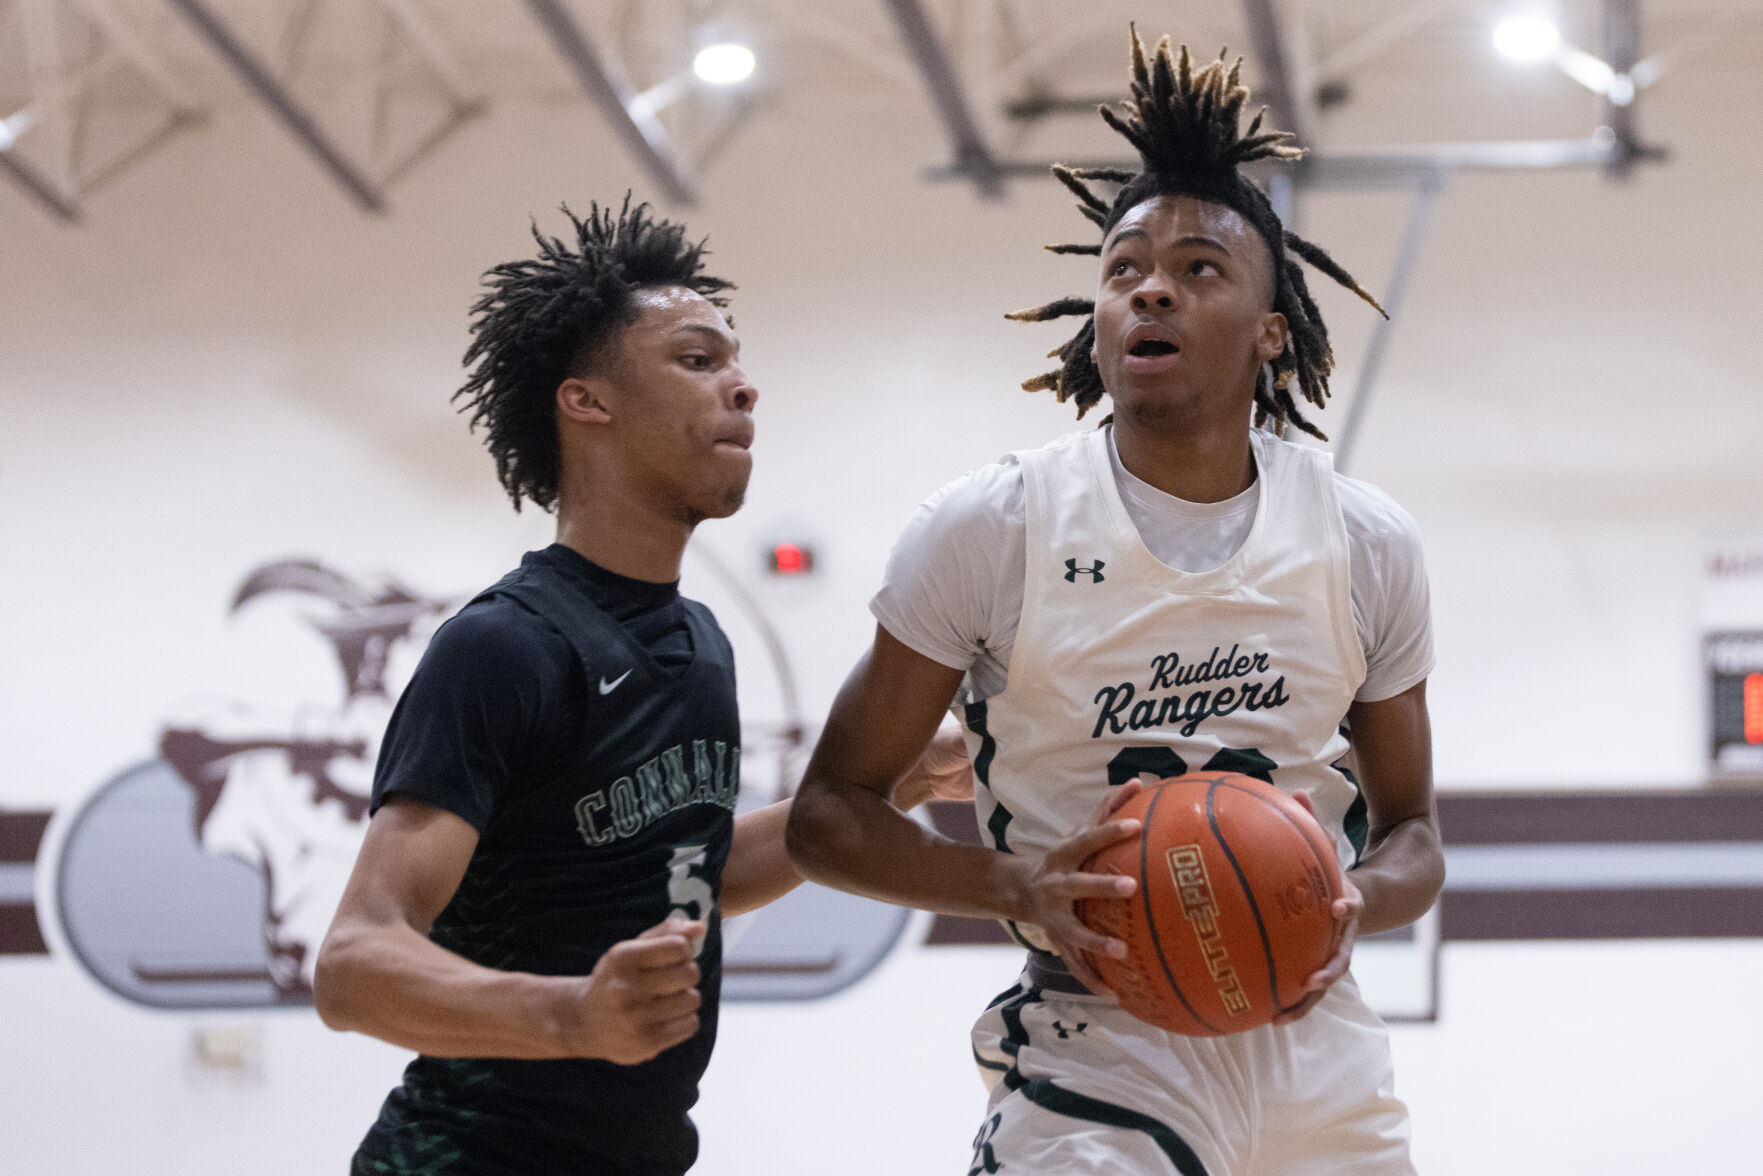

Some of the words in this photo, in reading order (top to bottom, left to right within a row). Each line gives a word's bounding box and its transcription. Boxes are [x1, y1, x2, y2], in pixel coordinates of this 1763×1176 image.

[1149, 643, 1269, 691] Rudder
[1091, 675, 1290, 739] Rangers
[666, 843, 714, 959] 5
[1170, 848, 1212, 908] PRO
[1187, 903, 1251, 1018] ELITE
